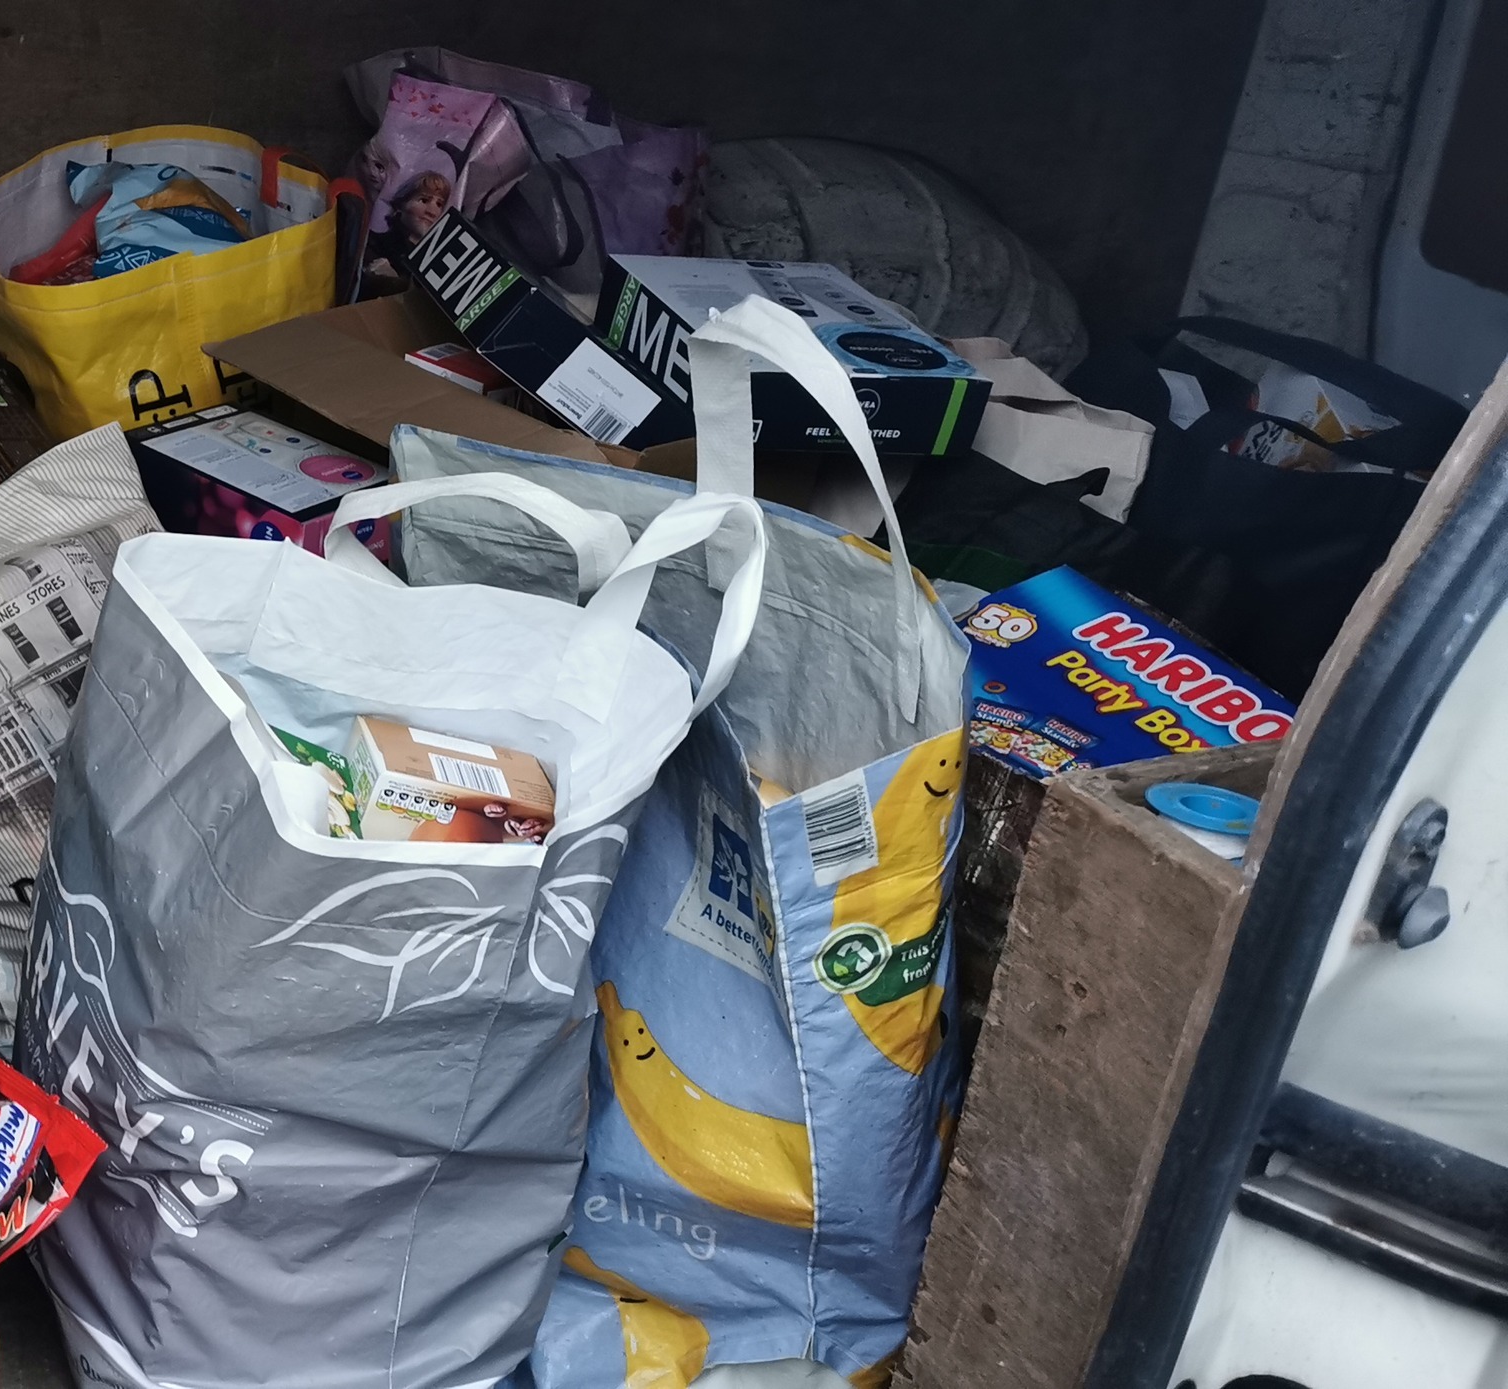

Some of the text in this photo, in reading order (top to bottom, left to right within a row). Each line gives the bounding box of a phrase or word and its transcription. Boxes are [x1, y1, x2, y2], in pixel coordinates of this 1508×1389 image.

[408, 213, 502, 316] MEN
[628, 291, 692, 404] ME
[805, 427, 831, 437] FEEL
[26, 574, 67, 606] STORES
[971, 605, 1034, 640] 50
[1046, 650, 1145, 715] Party
[1074, 612, 1296, 744] HARIBO
[975, 702, 1026, 722] HARIBO
[1045, 718, 1092, 745] HARIBO
[701, 902, 714, 921] A
[30, 905, 255, 1207] RVEY'S
